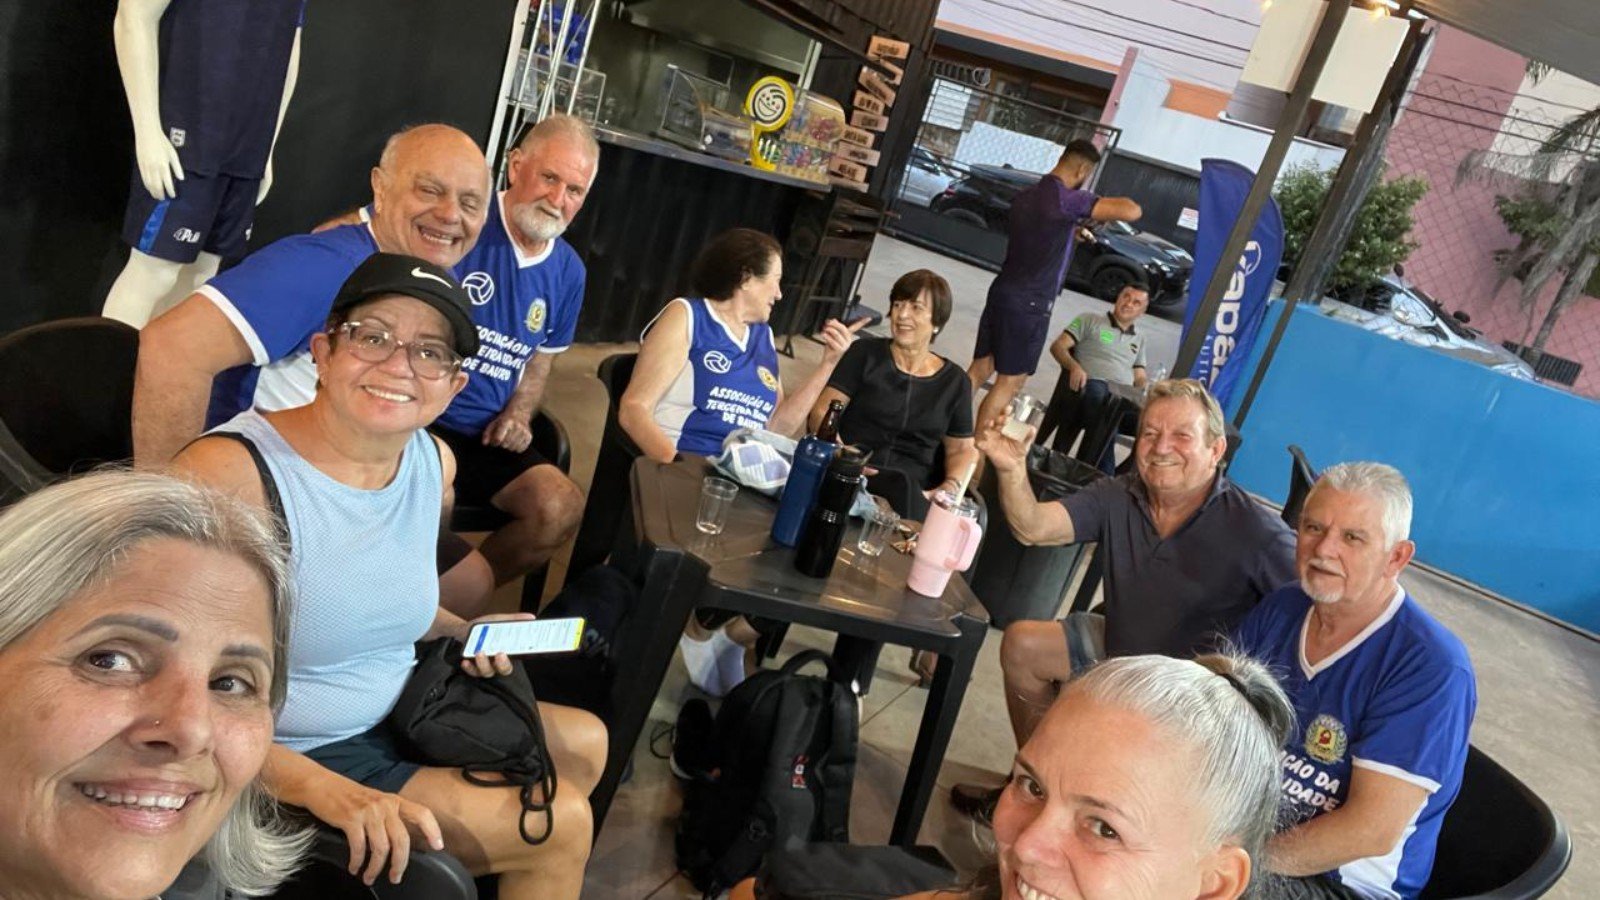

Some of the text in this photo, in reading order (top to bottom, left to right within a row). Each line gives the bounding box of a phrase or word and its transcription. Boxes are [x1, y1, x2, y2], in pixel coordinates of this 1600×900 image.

[462, 357, 480, 370] DE
[722, 412, 736, 424] DE
[1314, 771, 1340, 794] DA
